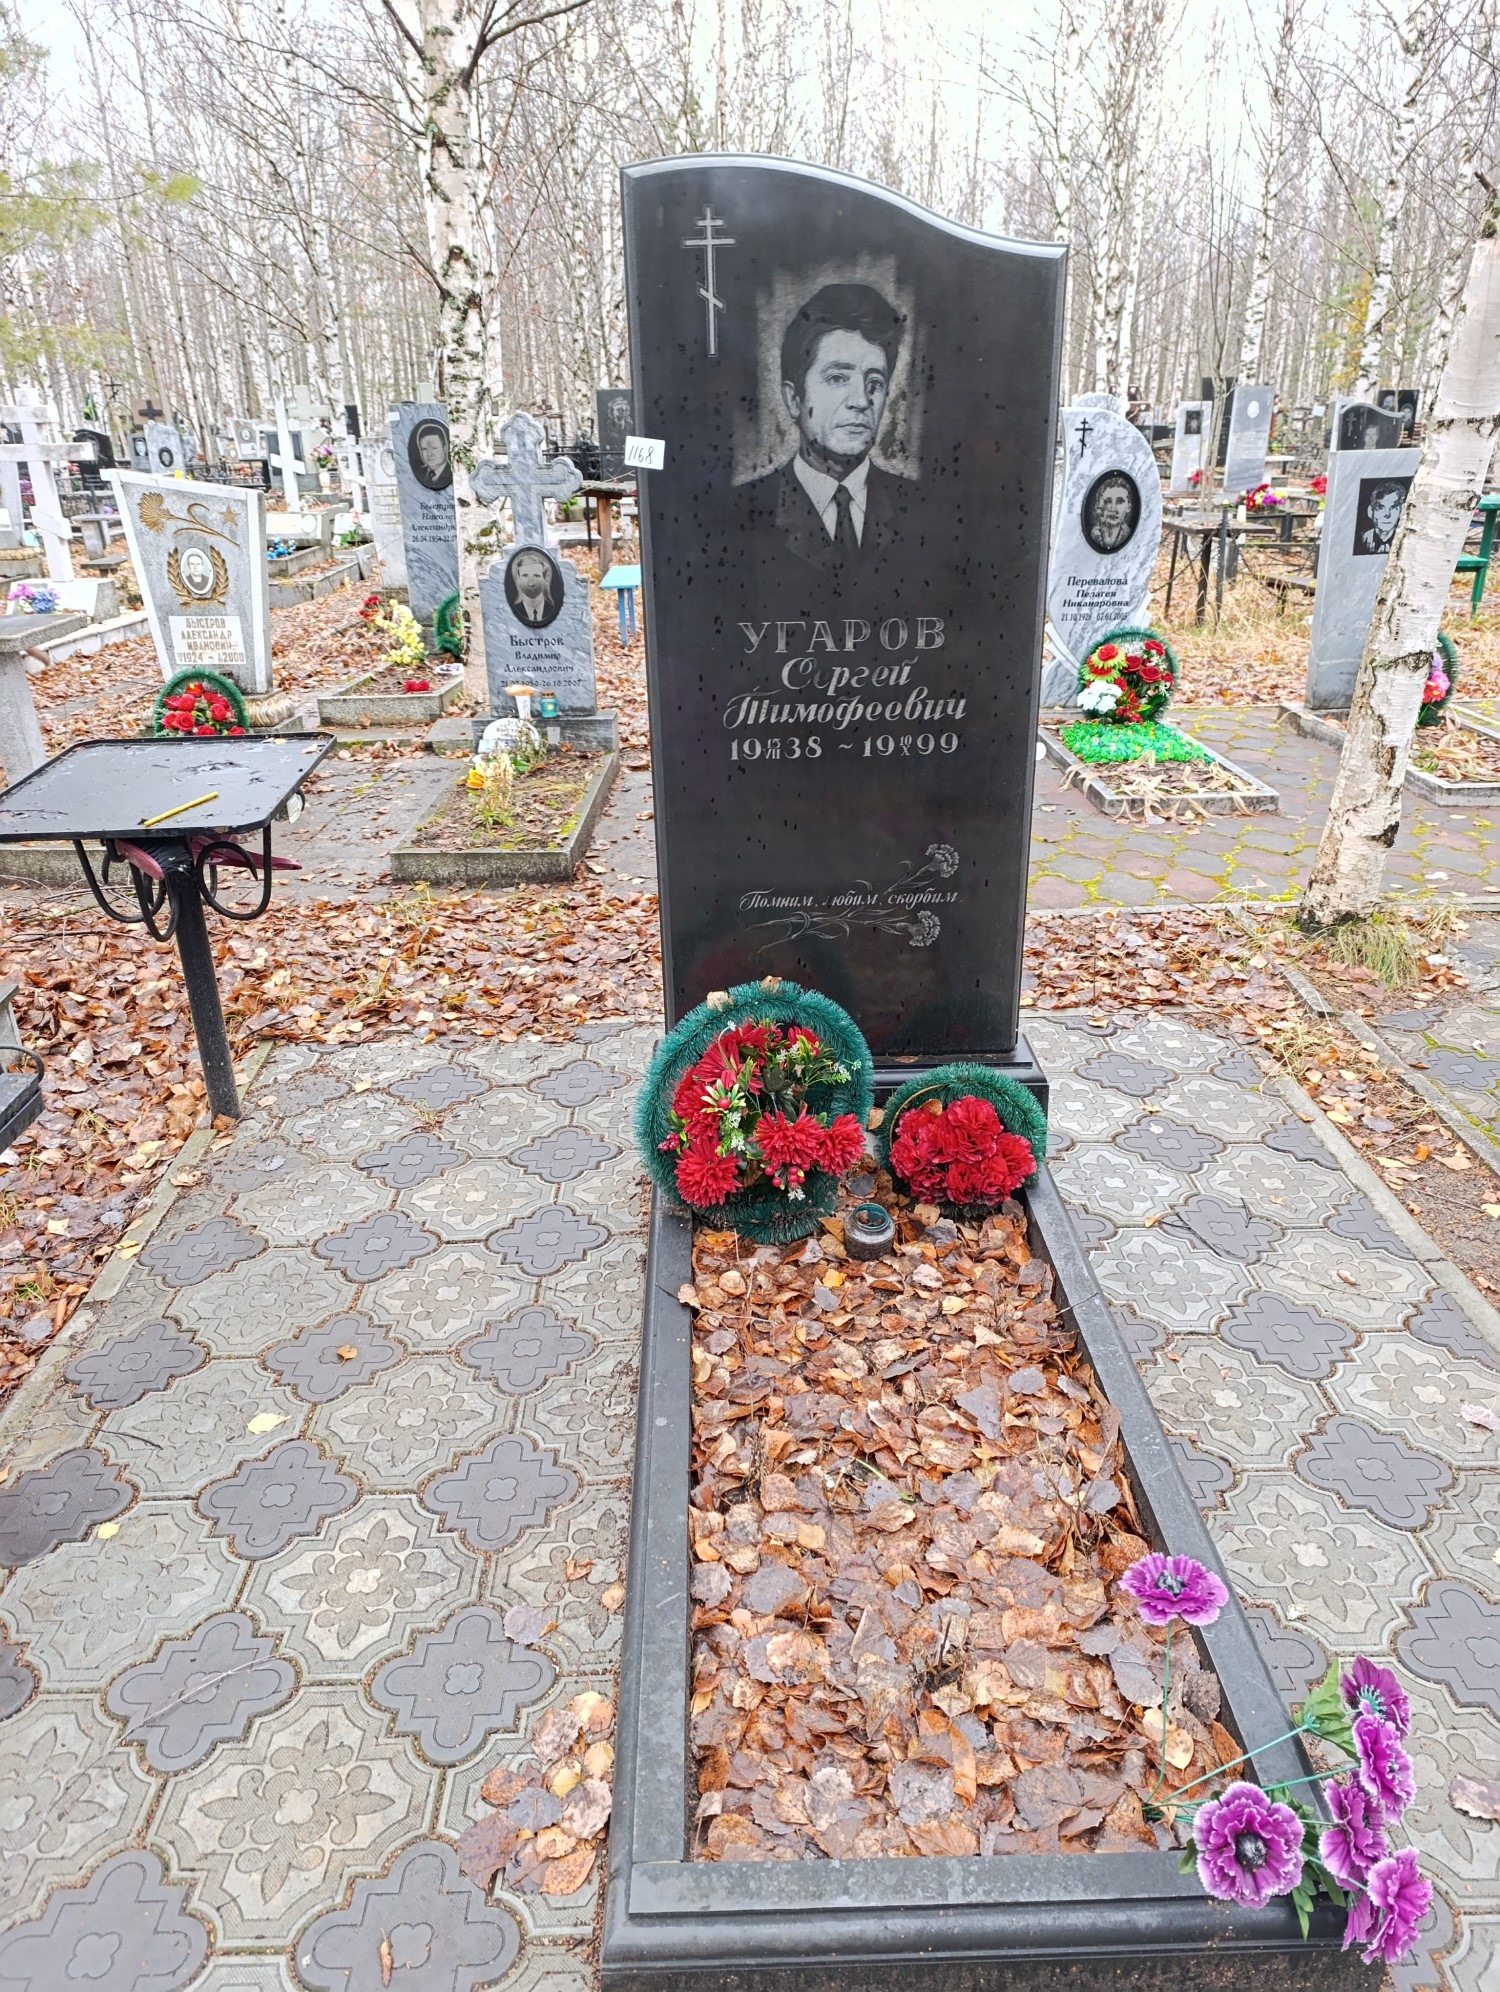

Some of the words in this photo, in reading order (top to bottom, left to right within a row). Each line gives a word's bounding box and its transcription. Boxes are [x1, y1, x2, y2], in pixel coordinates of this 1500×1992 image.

[627, 445, 655, 465] 1168
[1066, 576, 1128, 588] Перевалова
[1076, 589, 1117, 598] Пелагея
[185, 617, 226, 629] БЫСТРОВ
[181, 630, 232, 640] АЛЕКСАНДР
[736, 617, 946, 654] УГАРОВ
[186, 641, 232, 651] ИВАНОВИЧ
[509, 634, 565, 649] Быстров
[514, 651, 561, 661] Владимир
[504, 663, 574, 673] Александрович
[780, 656, 919, 696] Сергей
[722, 686, 967, 731] Тимофеевич
